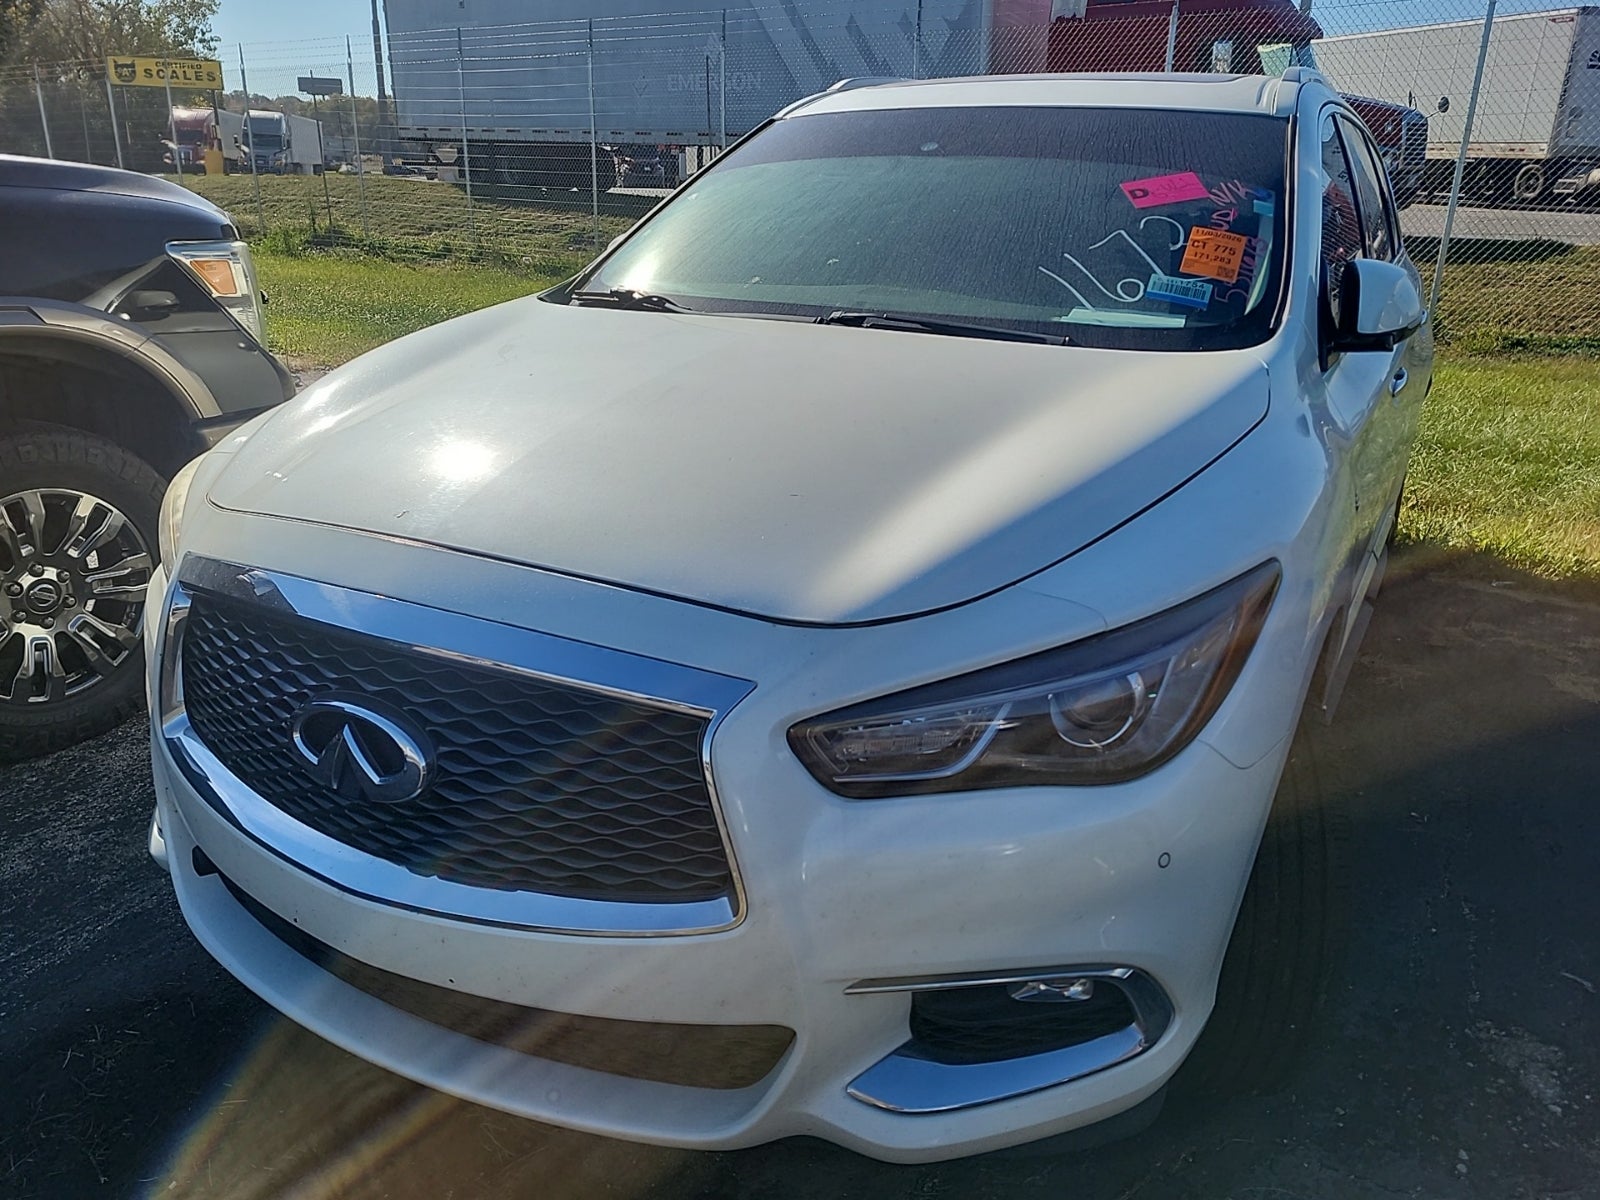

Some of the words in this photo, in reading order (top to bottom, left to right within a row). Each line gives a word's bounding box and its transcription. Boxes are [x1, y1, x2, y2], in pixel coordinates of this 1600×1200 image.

[155, 61, 202, 70] CERTIFIED
[143, 68, 217, 82] SCALES
[1191, 239, 1209, 250] CT
[1213, 243, 1237, 256] 775
